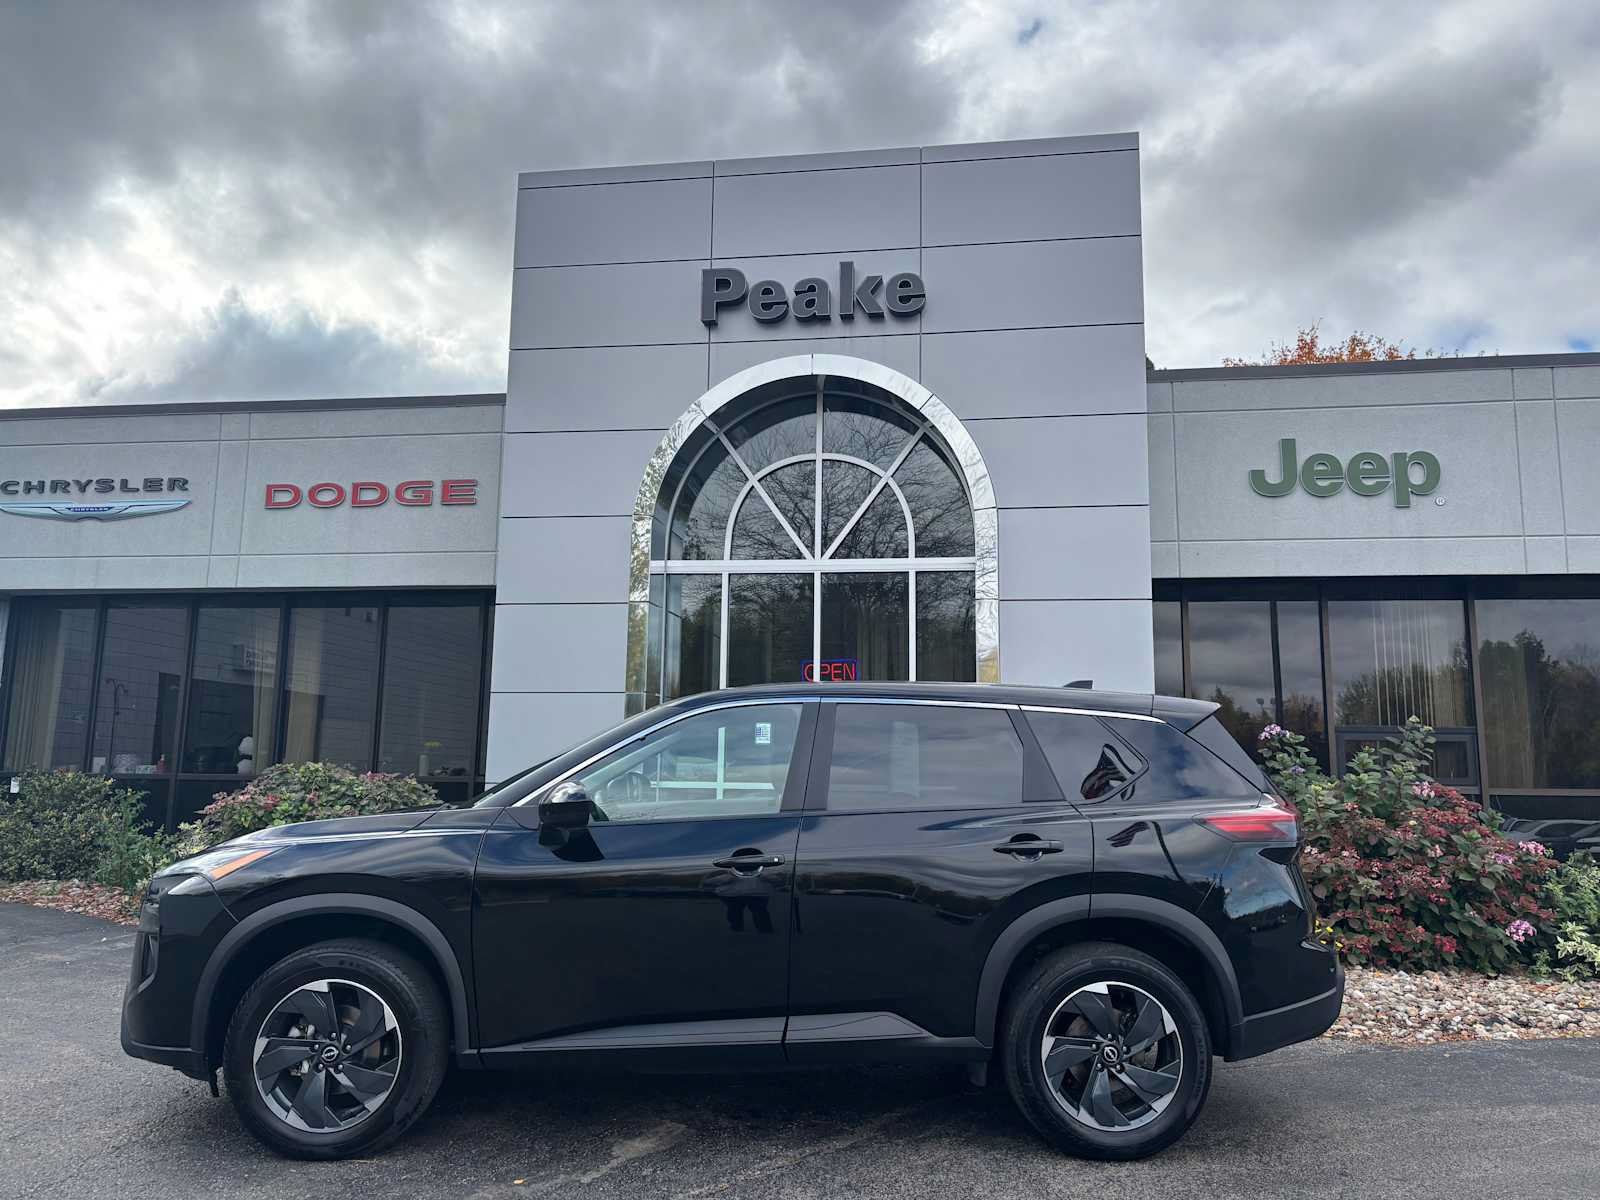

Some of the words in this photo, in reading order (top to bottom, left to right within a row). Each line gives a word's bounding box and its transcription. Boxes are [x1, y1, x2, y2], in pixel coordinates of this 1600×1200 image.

[700, 261, 926, 328] Peake
[1, 477, 190, 495] CHRYSLER
[265, 479, 479, 509] DODGE
[1250, 438, 1441, 507] Jeep
